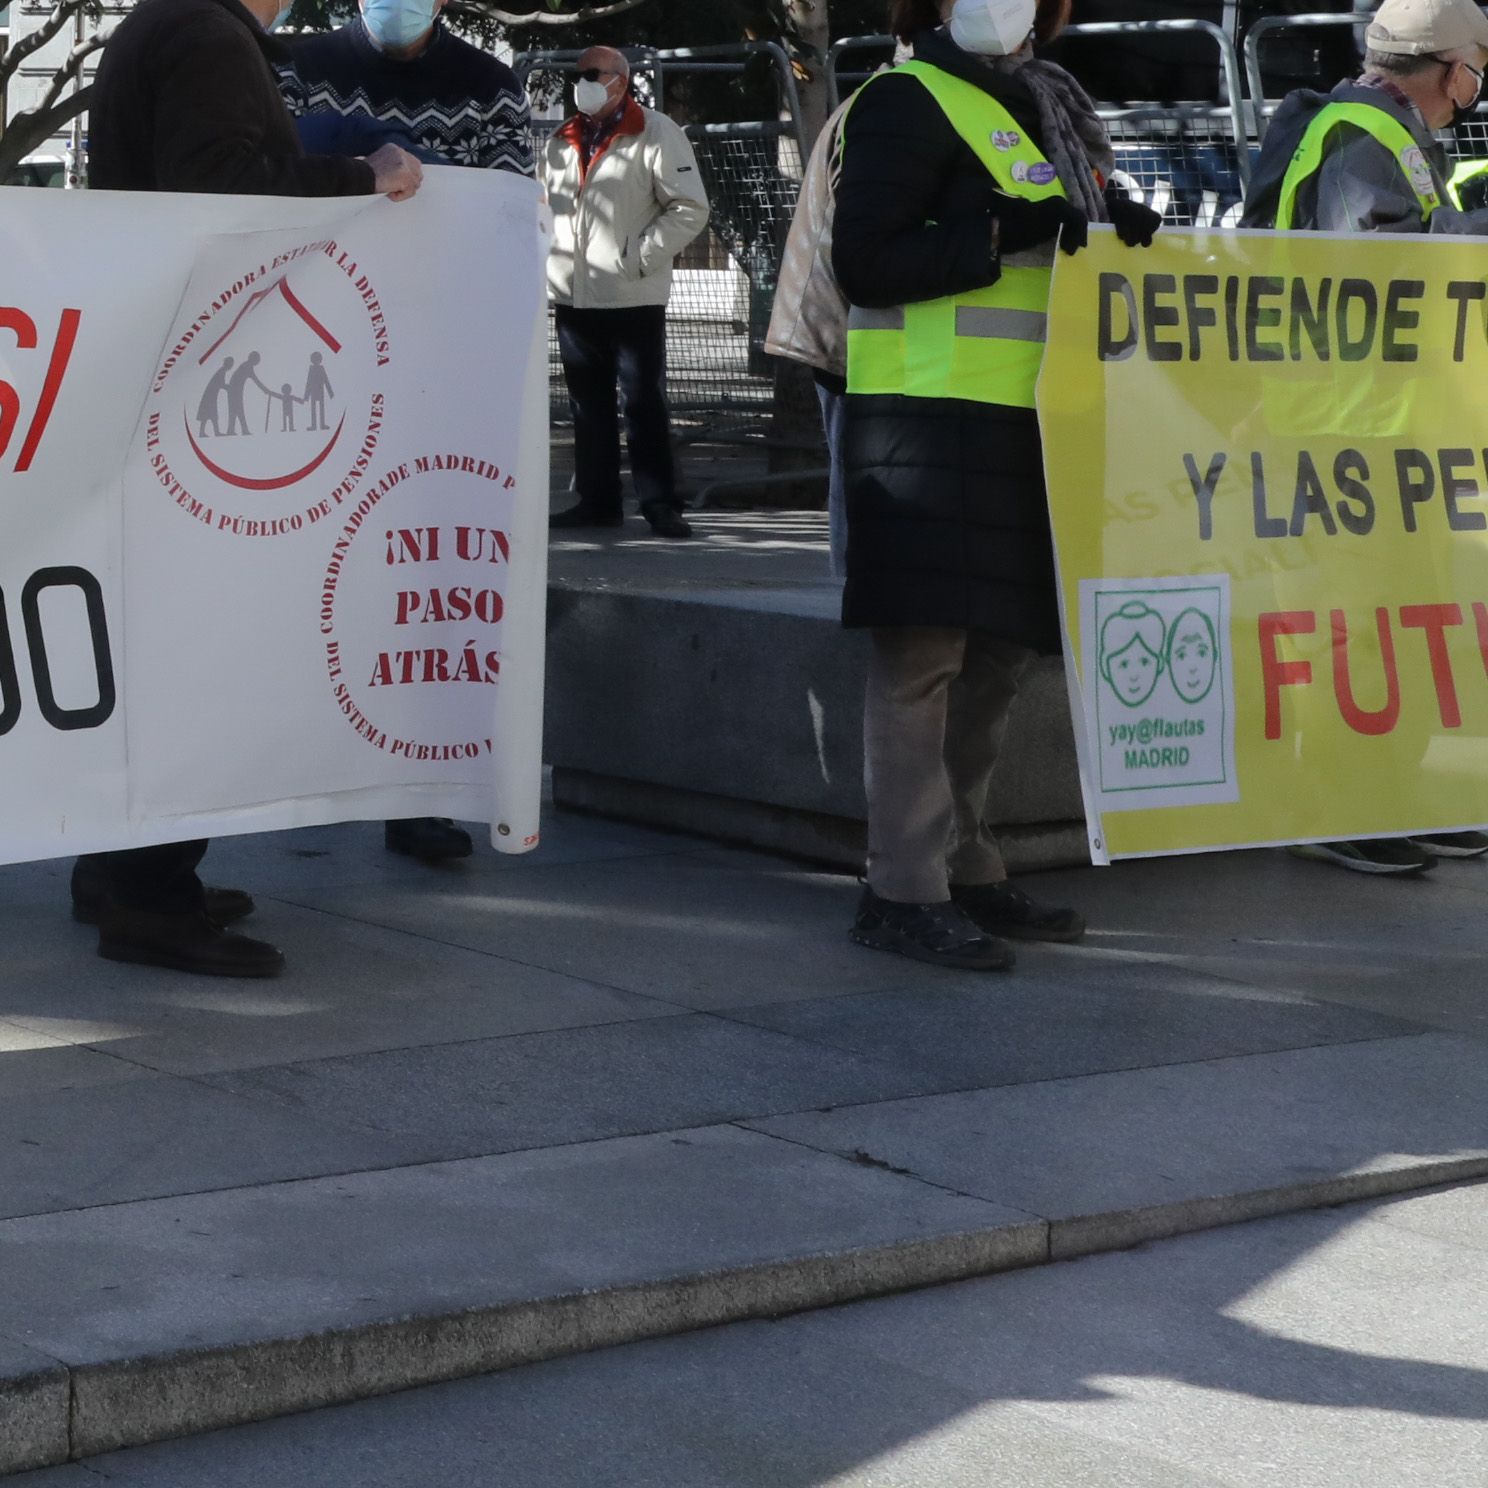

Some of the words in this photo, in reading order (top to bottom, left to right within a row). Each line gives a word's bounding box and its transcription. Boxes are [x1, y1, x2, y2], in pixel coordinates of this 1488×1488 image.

[153, 264, 267, 393] COORDINADORA
[336, 251, 358, 278] LA
[354, 275, 391, 367] DEFENSA
[1098, 272, 1425, 363] DEFIENDE
[1446, 279, 1488, 363] T
[146, 412, 161, 452] DEL
[331, 393, 385, 505] PENSIONES
[414, 454, 501, 481] MADRID
[150, 453, 214, 525] SISTEMA
[1183, 451, 1227, 540] Y
[1250, 448, 1375, 538] LAS
[1393, 448, 1488, 533] PE
[217, 513, 303, 537] PÚBLICO
[305, 499, 332, 524] DE
[393, 586, 504, 625] PASO
[326, 641, 342, 682] DEL
[367, 639, 501, 687] ATRÁS
[333, 683, 387, 750] SISTEMA
[389, 738, 479, 761] PÚBLICO
[1124, 746, 1190, 770] MADRID
